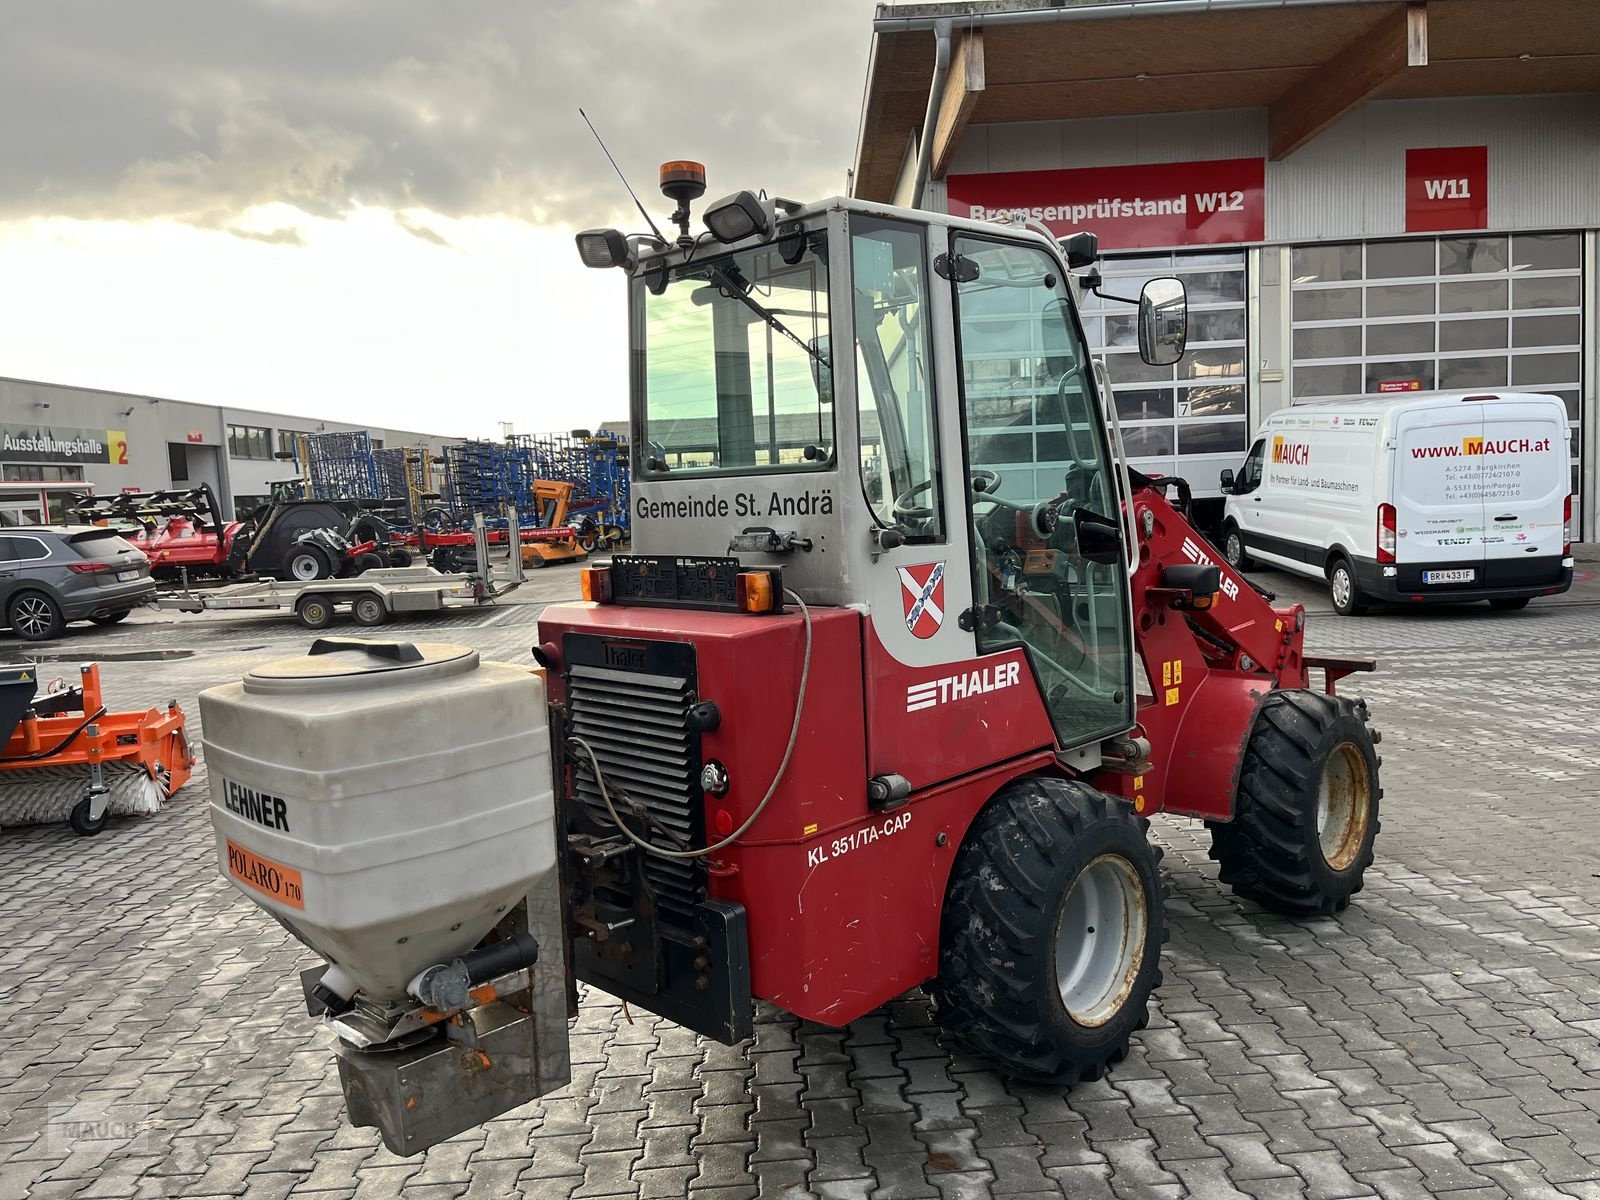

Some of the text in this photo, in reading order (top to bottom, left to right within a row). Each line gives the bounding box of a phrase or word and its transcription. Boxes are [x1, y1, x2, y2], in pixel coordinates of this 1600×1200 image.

[1424, 178, 1471, 200] W11
[1194, 191, 1244, 213] W12
[1262, 360, 1268, 368] 7
[1180, 403, 1188, 416] 7
[3, 433, 129, 464] Ausstellungshalle 2
[1274, 444, 1310, 466] MAUCH
[1445, 463, 1521, 473] A-5274 Burgkirchen
[1276, 475, 1290, 484] Partner
[1298, 477, 1310, 487] Land-
[1311, 479, 1320, 488] und
[1321, 479, 1359, 492] Baumaschinen
[1473, 482, 1521, 491] Eben/Pongau
[636, 489, 833, 519] Gemeinde St. Andrä
[1437, 537, 1473, 546] FENDT
[1198, 549, 1239, 602] TLER
[1430, 572, 1441, 581] BR
[1446, 571, 1461, 579] 433
[602, 641, 647, 668] Thaler
[937, 661, 1020, 704] THALER
[222, 778, 290, 833] LEHNER
[807, 812, 913, 868] KL 351/TA-CAP
[284, 881, 301, 901] 170
